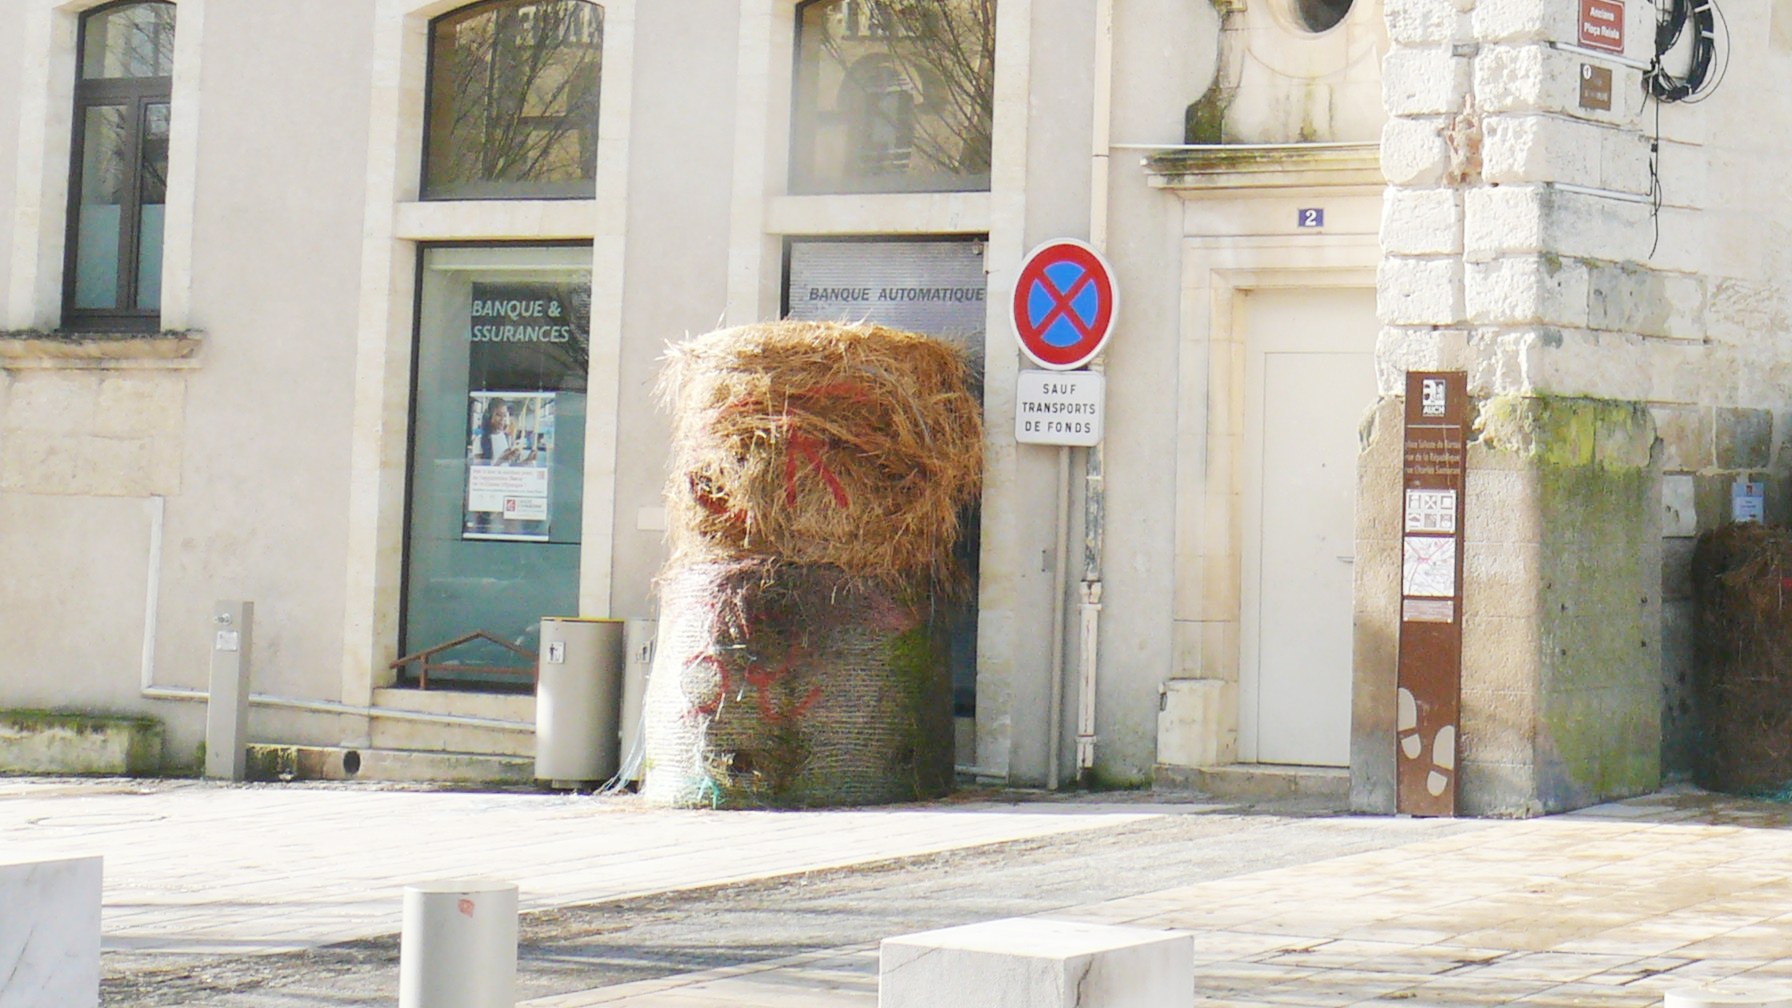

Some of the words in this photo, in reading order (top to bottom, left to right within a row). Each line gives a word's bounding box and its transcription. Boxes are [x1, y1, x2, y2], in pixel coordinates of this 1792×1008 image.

[1304, 209, 1317, 227] 2
[809, 287, 870, 302] BANQUE
[878, 287, 985, 302] AUTOMATIQUE
[472, 300, 544, 320] BANQUE
[547, 300, 561, 317] &
[1042, 383, 1077, 394] SAUF
[1022, 402, 1097, 415] TRANSPORTS
[1024, 421, 1041, 433] DE
[1047, 421, 1092, 434] FONDS
